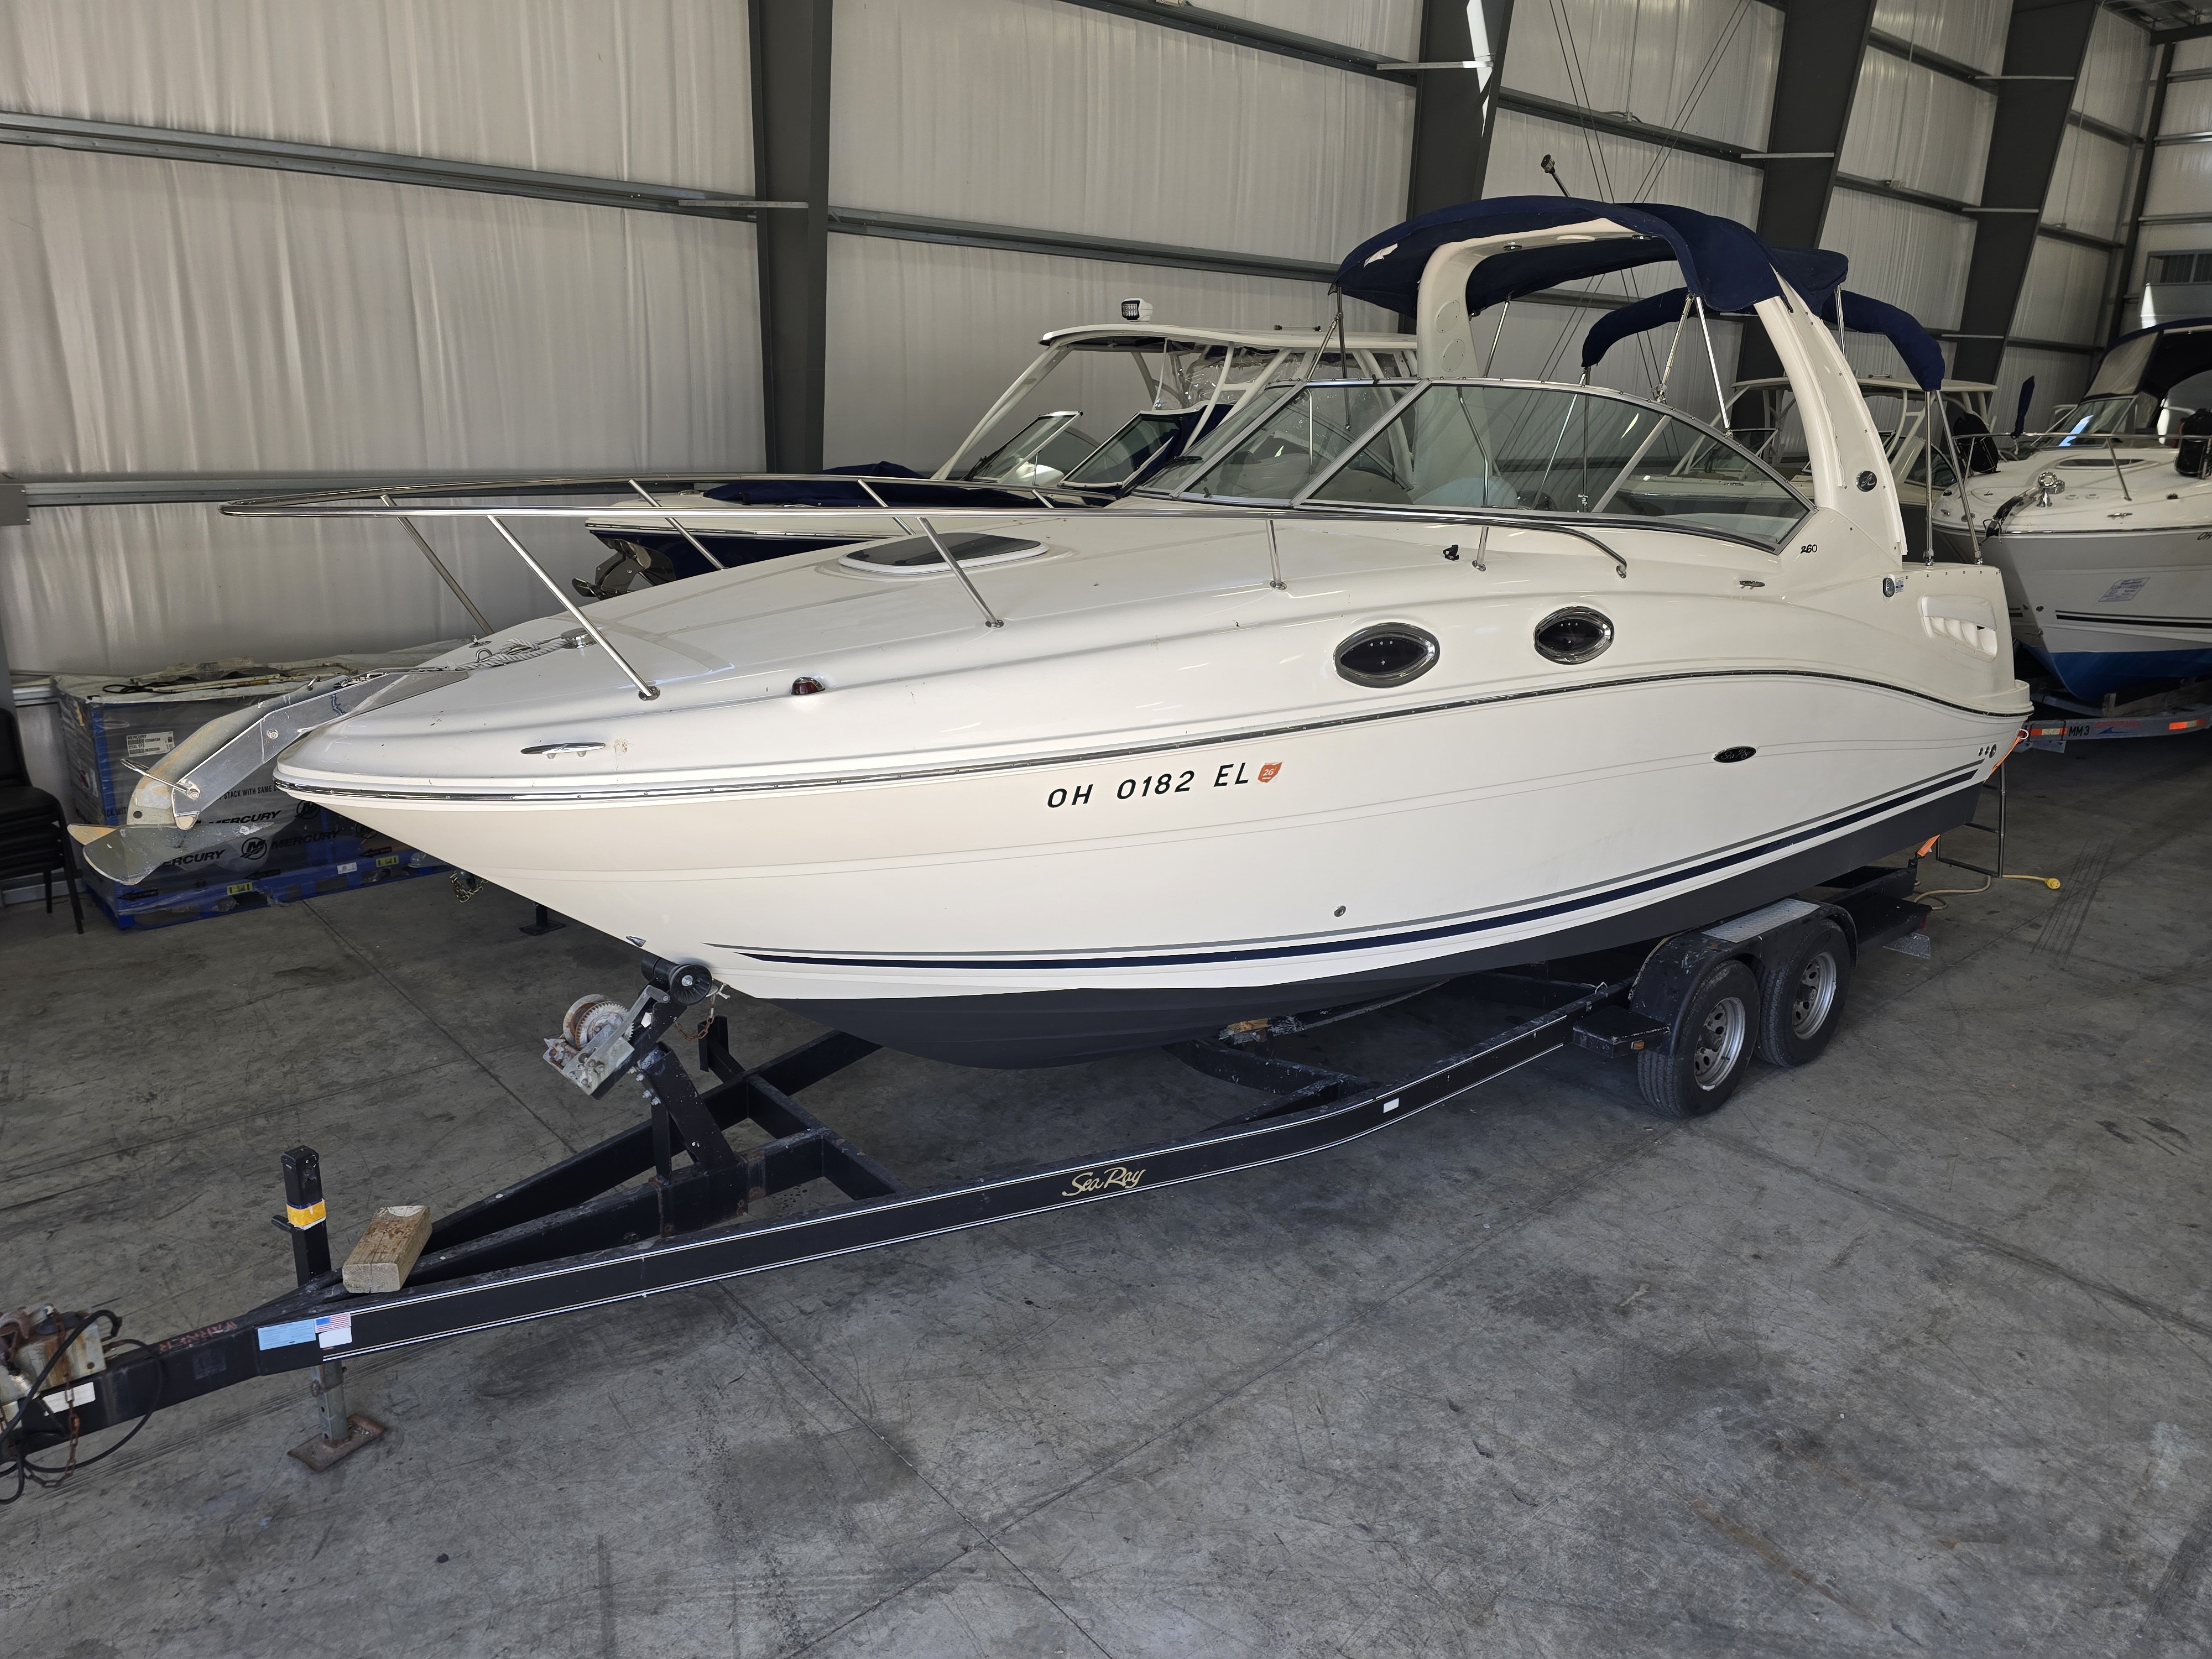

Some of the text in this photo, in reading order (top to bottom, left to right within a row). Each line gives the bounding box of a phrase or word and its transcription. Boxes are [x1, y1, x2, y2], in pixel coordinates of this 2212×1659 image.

[1800, 544, 1818, 554] 260
[1262, 768, 1275, 776] 26
[224, 789, 241, 799] STACK
[242, 787, 256, 796] WITH
[258, 785, 272, 794] SAME
[1047, 762, 1249, 808] OH 0182 EL
[208, 810, 281, 823] ERCURY
[271, 830, 341, 849] MERCURY
[161, 849, 226, 867] ERCURY
[1061, 1167, 1146, 1196] Sea Ray
